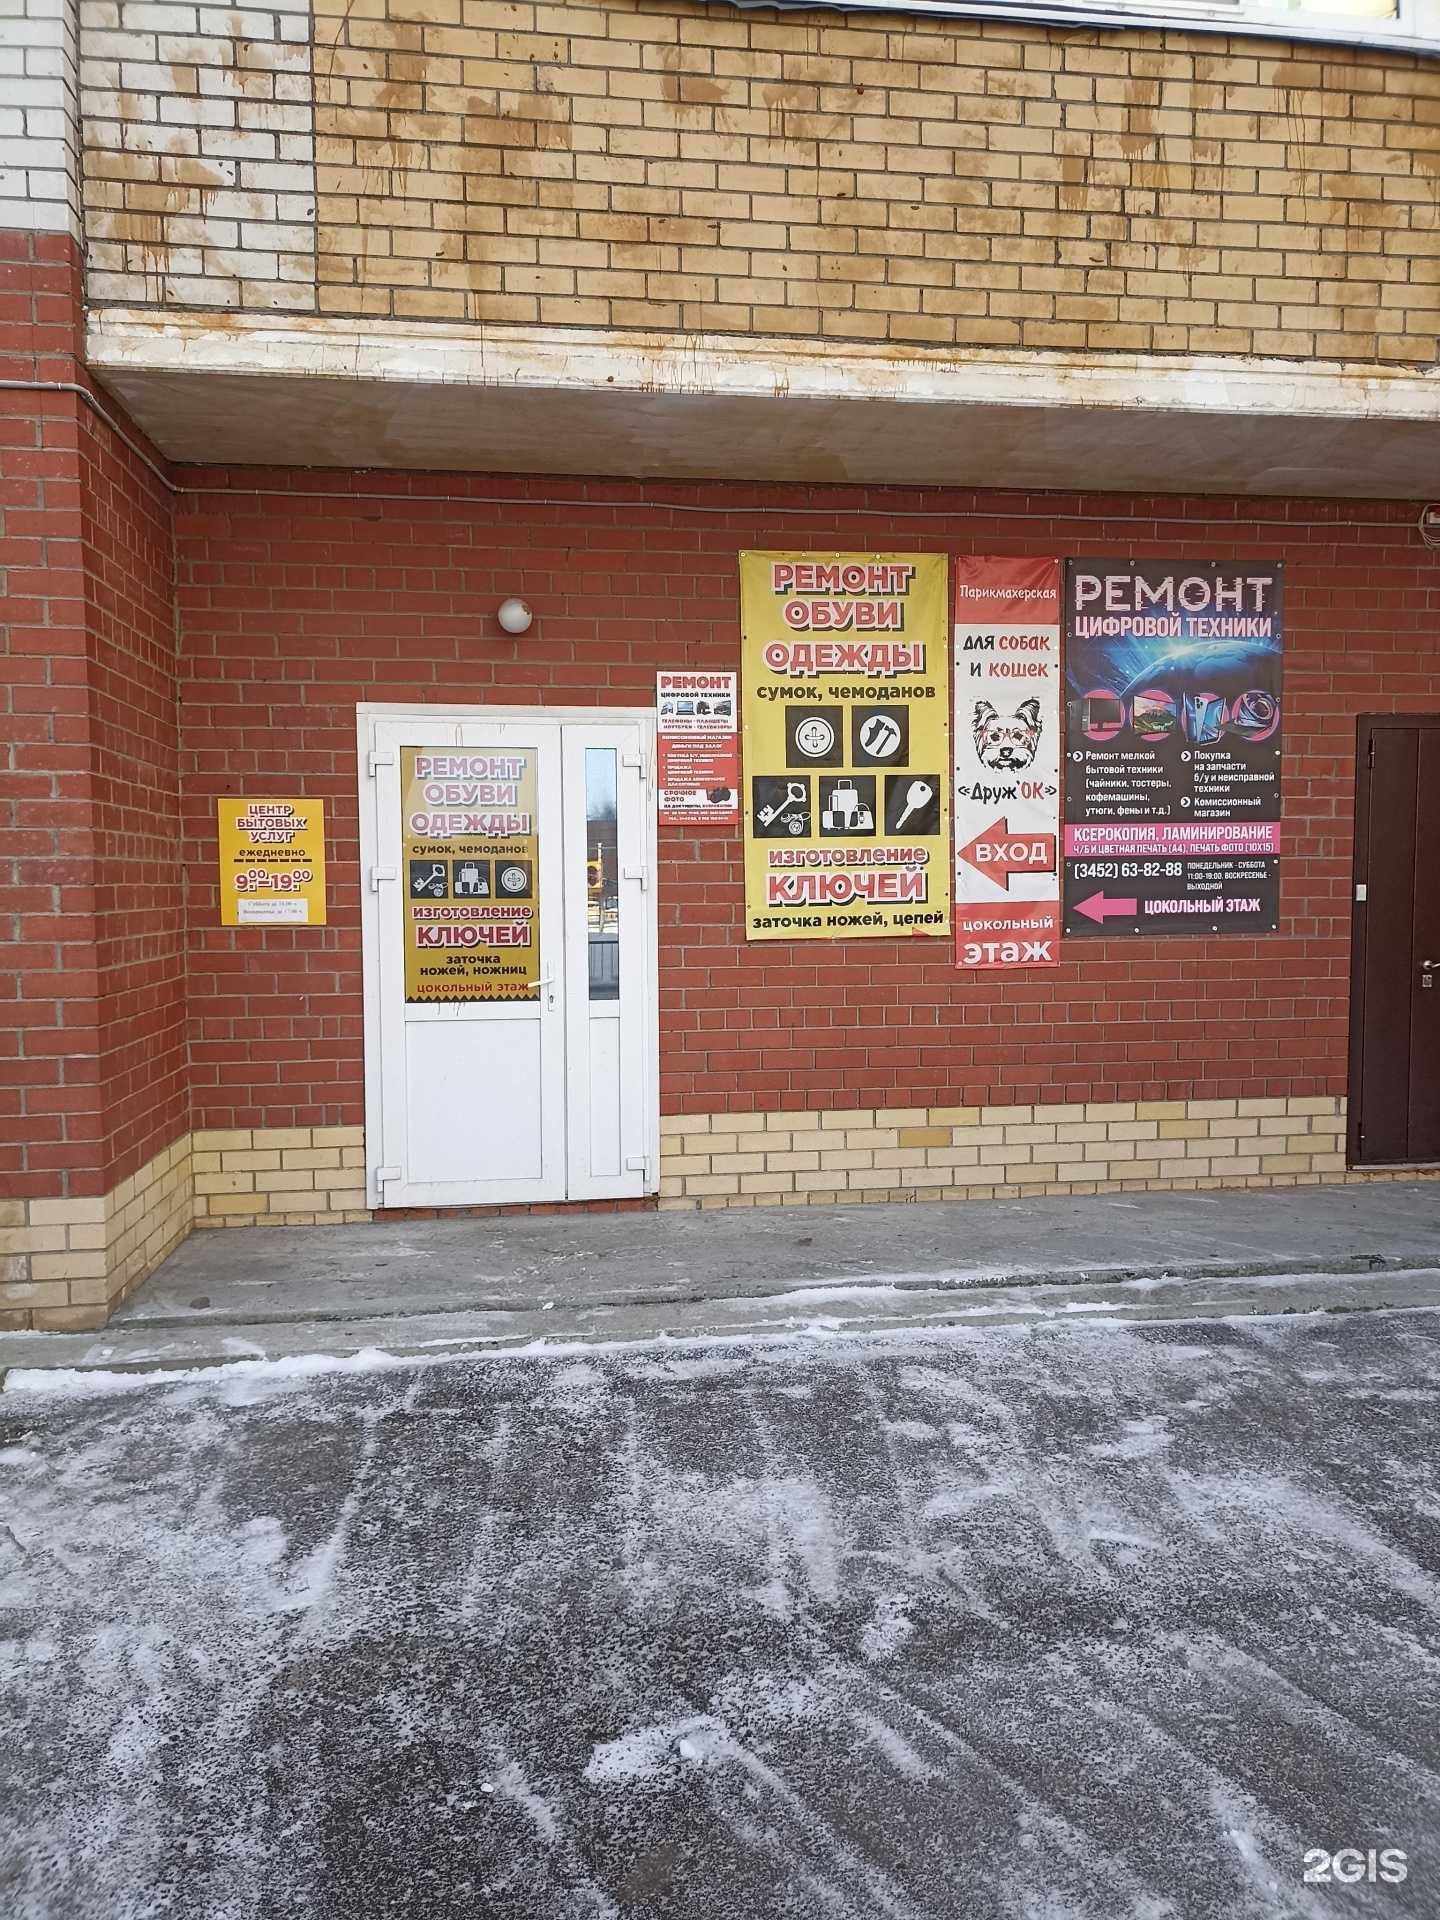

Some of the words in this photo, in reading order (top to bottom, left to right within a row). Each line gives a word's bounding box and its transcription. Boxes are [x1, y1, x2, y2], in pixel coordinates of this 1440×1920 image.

[772, 563, 914, 593] РЕМОНТ
[959, 584, 1057, 601] Парикмахерская
[1074, 574, 1273, 613] РЕМОНТ
[784, 600, 903, 629] ОБУВИ
[1075, 612, 1182, 639] ЦИФРОВОЙ
[1185, 616, 1272, 639] ТЕХНИКИ
[764, 641, 925, 676] ОДЕЖДЫ
[660, 675, 732, 689] РЕМОНТ
[756, 685, 823, 701] сумок,
[828, 685, 936, 699] чемоданов
[1085, 750, 1120, 761] Ремонт
[1120, 750, 1156, 760] мелкой
[1194, 750, 1231, 761] Покупка
[415, 756, 526, 780] РЕМОНТ
[1085, 764, 1126, 775] бытовой
[1126, 765, 1164, 774] техники
[1193, 763, 1205, 771] на
[1206, 762, 1247, 771] запчасти
[1193, 772, 1210, 784] б/у
[1210, 774, 1217, 782] и
[1217, 771, 1275, 782] неисправной
[423, 782, 517, 806] ОБУВИ
[1193, 784, 1231, 793] техники
[1085, 791, 1150, 803] кофемашины,
[1194, 796, 1262, 807] Комиссионный
[248, 804, 294, 817] ЦЕНТР
[1116, 805, 1144, 817] фены
[1144, 806, 1150, 815] и
[1193, 809, 1231, 817] магазин
[236, 816, 307, 830] БЫТОВЫХ
[410, 812, 531, 838] ОДЕЖДЫ
[250, 830, 296, 843] УСЛУГ
[1074, 827, 1160, 842] КСЕРОКОПИЯ,
[1162, 825, 1274, 841] ЛАМИНИРОВАНИЕ
[239, 849, 306, 858] ежедневно
[412, 844, 456, 855] сумок,
[975, 842, 1048, 865] ВХОД
[1073, 844, 1090, 855] Ч/Б
[1090, 845, 1097, 854] И
[1098, 844, 1136, 855] ЦВЕТНАЯ
[1136, 843, 1168, 853] ПЕЧАТЬ
[1190, 843, 1220, 853] ПЕЧАТЬ
[1220, 842, 1244, 852] ФОТО
[768, 847, 929, 866] изготовление
[1074, 862, 1120, 880] (3452)
[1121, 861, 1183, 877] 63-82-88
[1186, 862, 1234, 870] ПОНЕДЕЛЬНИК
[1238, 861, 1266, 869] СУББОТА
[1224, 871, 1269, 879] ВОСКРЕСЕНЬЕ
[766, 866, 928, 906] КЛЮЧЕЙ
[1186, 881, 1223, 891] ВЫХОДНОЙ
[412, 906, 533, 919] изготовление
[1144, 896, 1224, 916] ЦОКОЛЬНЫЙ
[1225, 898, 1261, 914] ЭТАЖ
[753, 915, 822, 929] заточка
[826, 911, 888, 928] ножей,
[893, 910, 944, 926] цепей
[962, 915, 1054, 932] цокольный
[416, 920, 531, 948] КЛЮЧЕЙ
[963, 941, 1053, 964] этаж
[446, 955, 501, 965] заточка
[420, 965, 469, 976] ножей,
[473, 966, 527, 976] ножниц
[417, 981, 492, 994] цокольный
[497, 983, 528, 992] этаж
